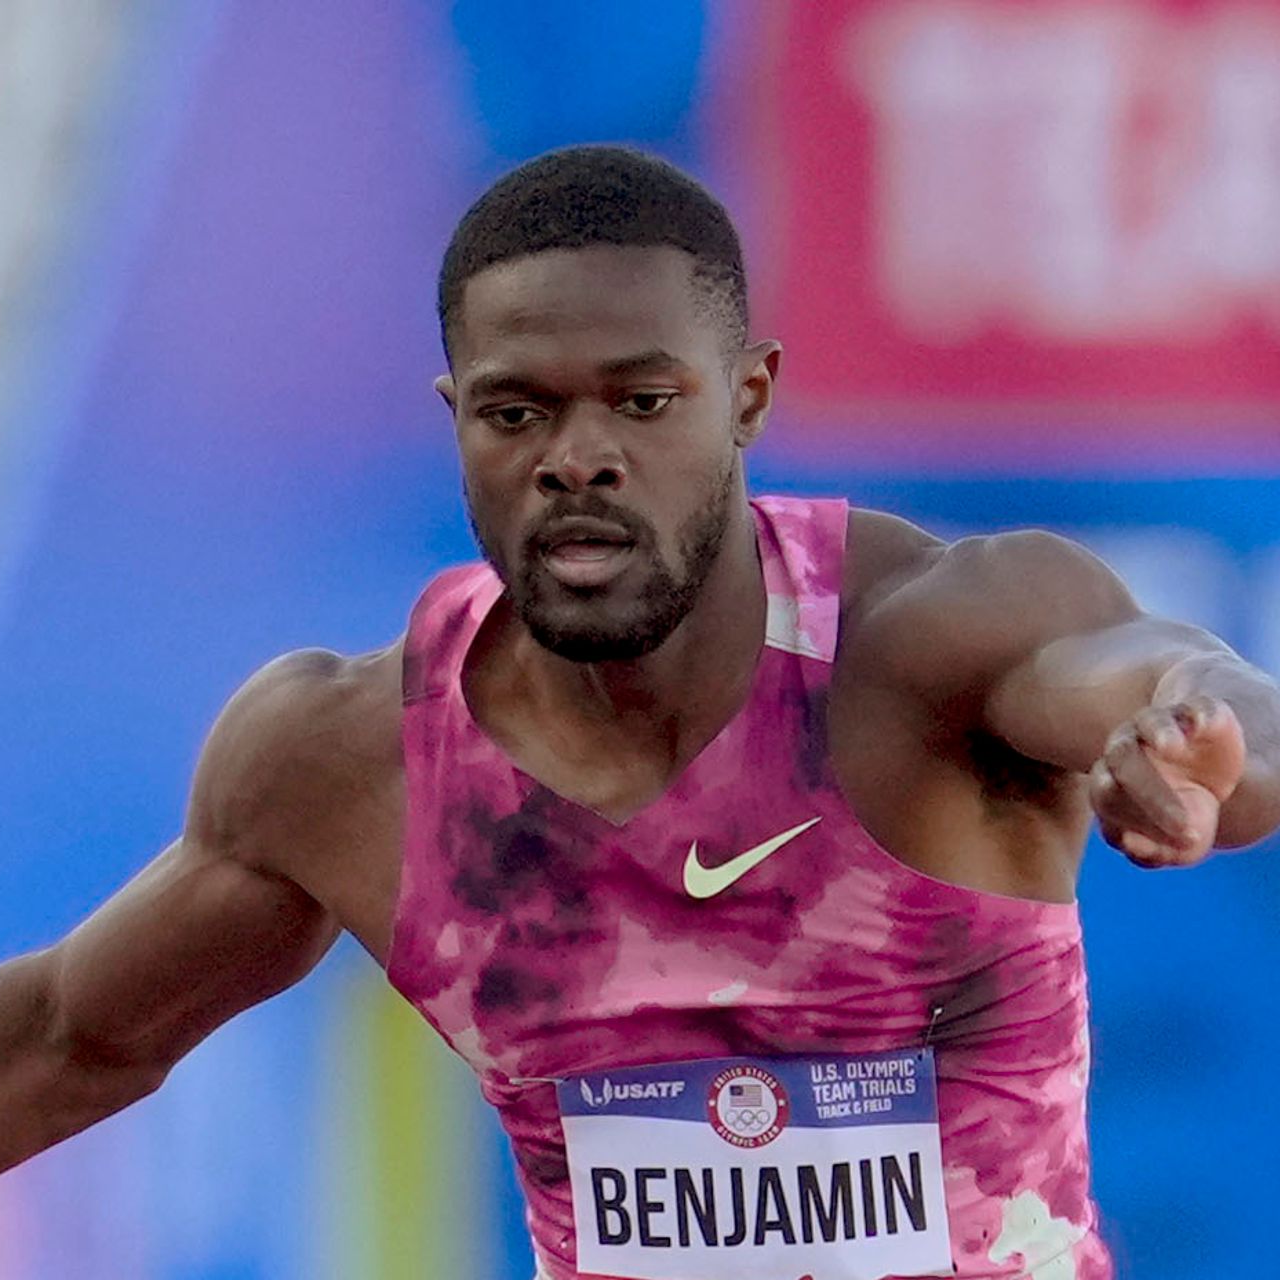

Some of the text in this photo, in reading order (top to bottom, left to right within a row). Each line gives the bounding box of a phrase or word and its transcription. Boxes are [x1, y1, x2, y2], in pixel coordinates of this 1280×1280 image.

[811, 1059, 915, 1083] U.S. OLYMPIC
[613, 1081, 685, 1100] USATF
[812, 1078, 916, 1104] TEAM TRIALS
[816, 1102, 852, 1119] TRACK
[863, 1098, 892, 1114] FIELD
[590, 1151, 927, 1248] BENJAMIN
